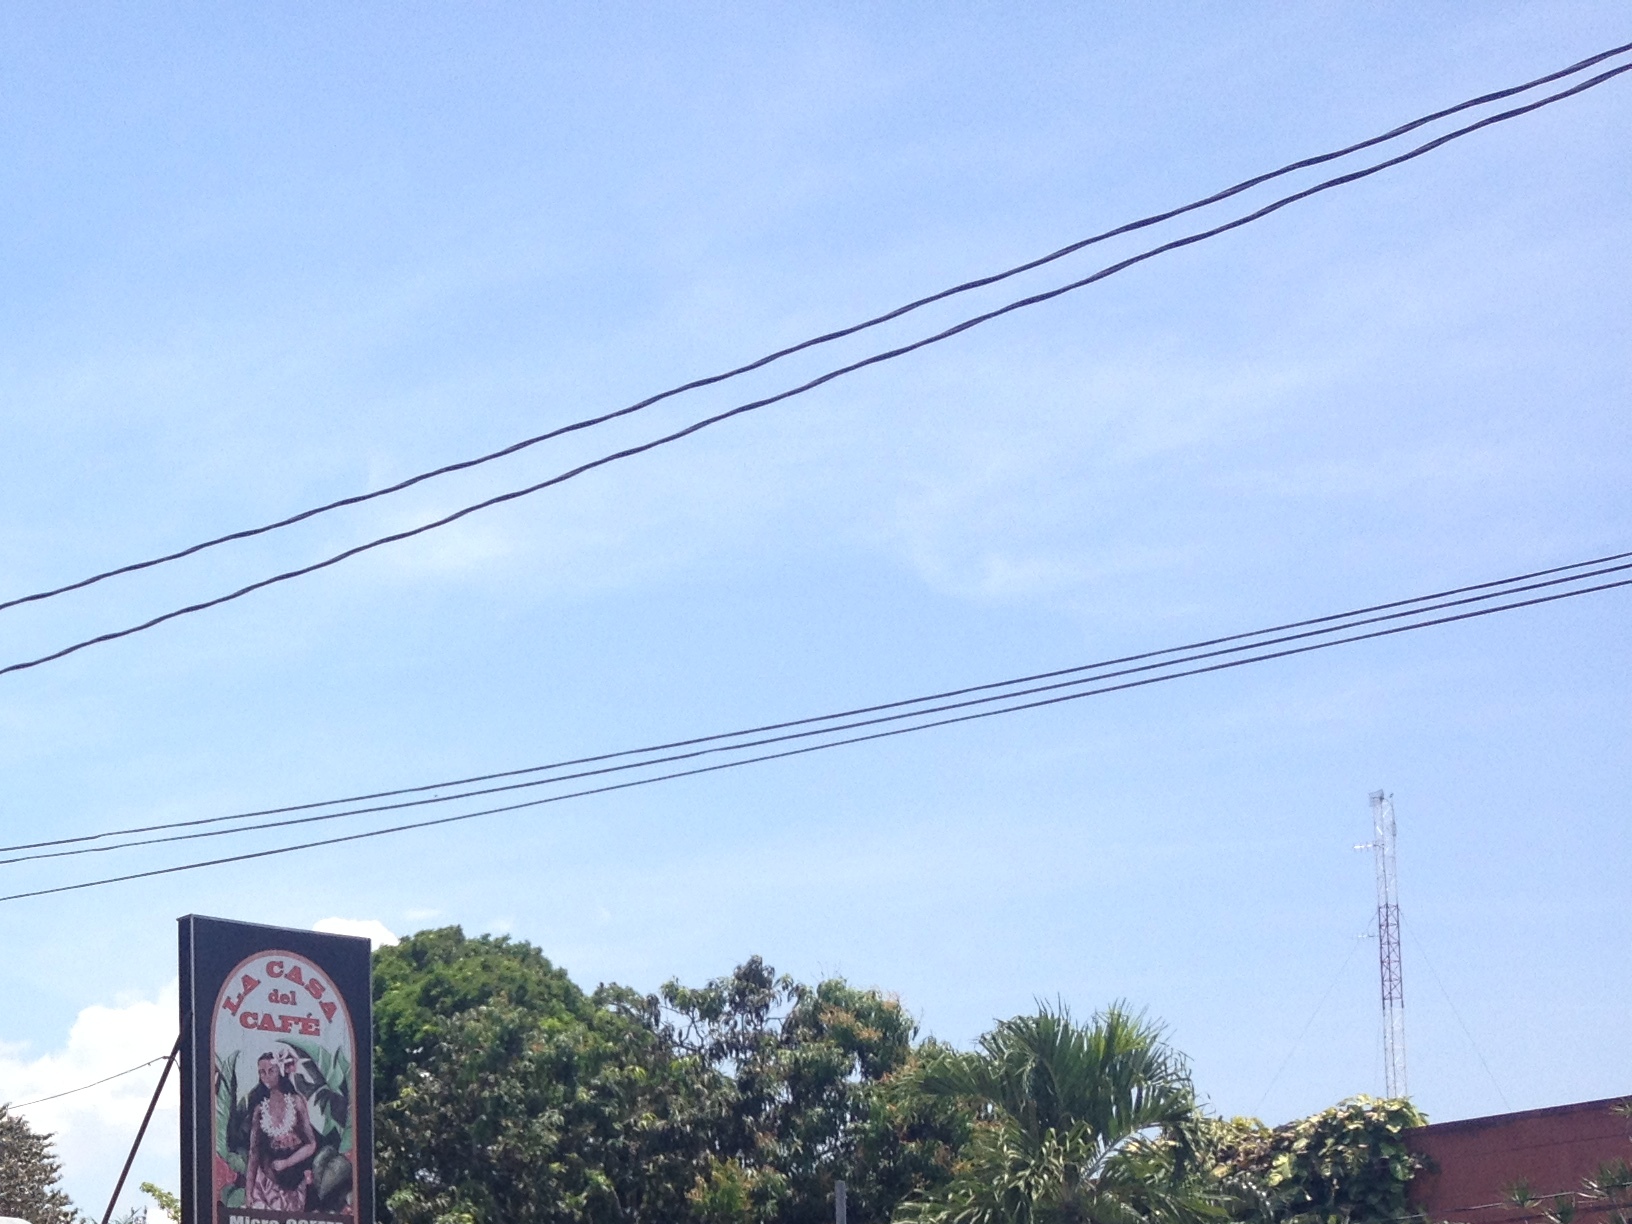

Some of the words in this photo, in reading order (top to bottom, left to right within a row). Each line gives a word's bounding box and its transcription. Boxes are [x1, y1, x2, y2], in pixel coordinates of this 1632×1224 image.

[222, 974, 261, 1016] LA
[266, 961, 338, 1023] CASA
[268, 989, 297, 1006] del
